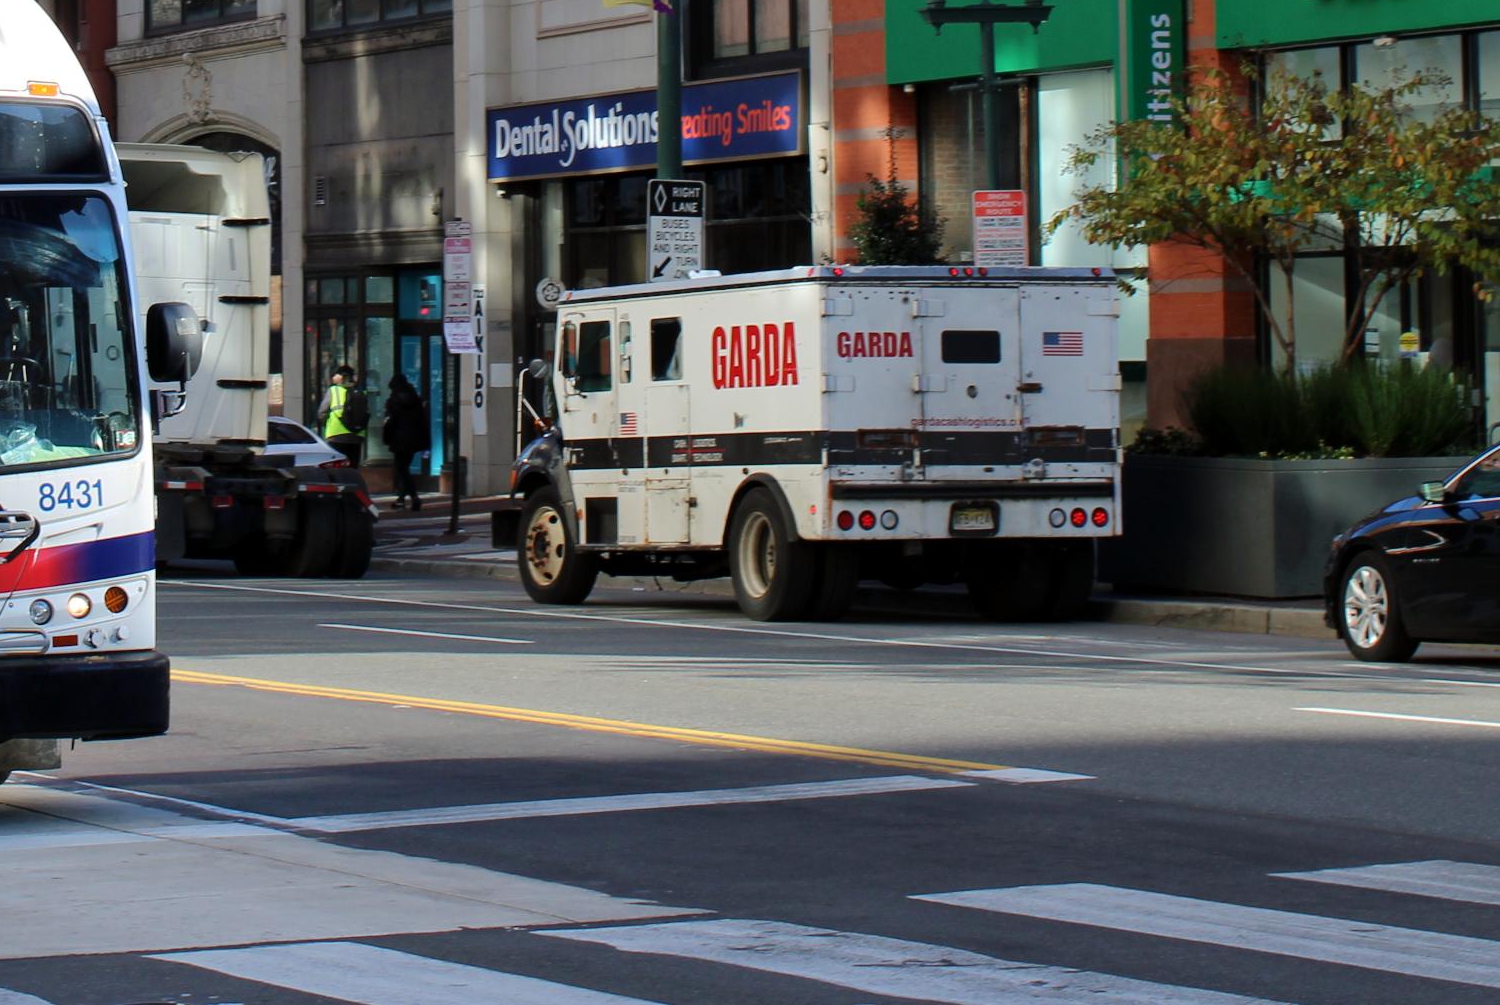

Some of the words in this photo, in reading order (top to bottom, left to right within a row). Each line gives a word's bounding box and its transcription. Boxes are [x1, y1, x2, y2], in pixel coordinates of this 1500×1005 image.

[1146, 12, 1173, 135] itizens
[494, 108, 561, 159] Dental
[559, 101, 659, 168] Solutions
[681, 105, 733, 147] eating
[736, 99, 792, 135] Smiles
[671, 186, 701, 198] RIGHT
[671, 201, 699, 213] LANE
[655, 230, 696, 242] BICYCLES
[661, 218, 690, 229] BUSES
[653, 243, 671, 254] AND
[674, 243, 699, 254] RIGHT
[474, 299, 485, 409] AIKIDO
[711, 321, 799, 390] GARDA
[836, 331, 914, 359] GARDA
[38, 478, 104, 512] 8431
